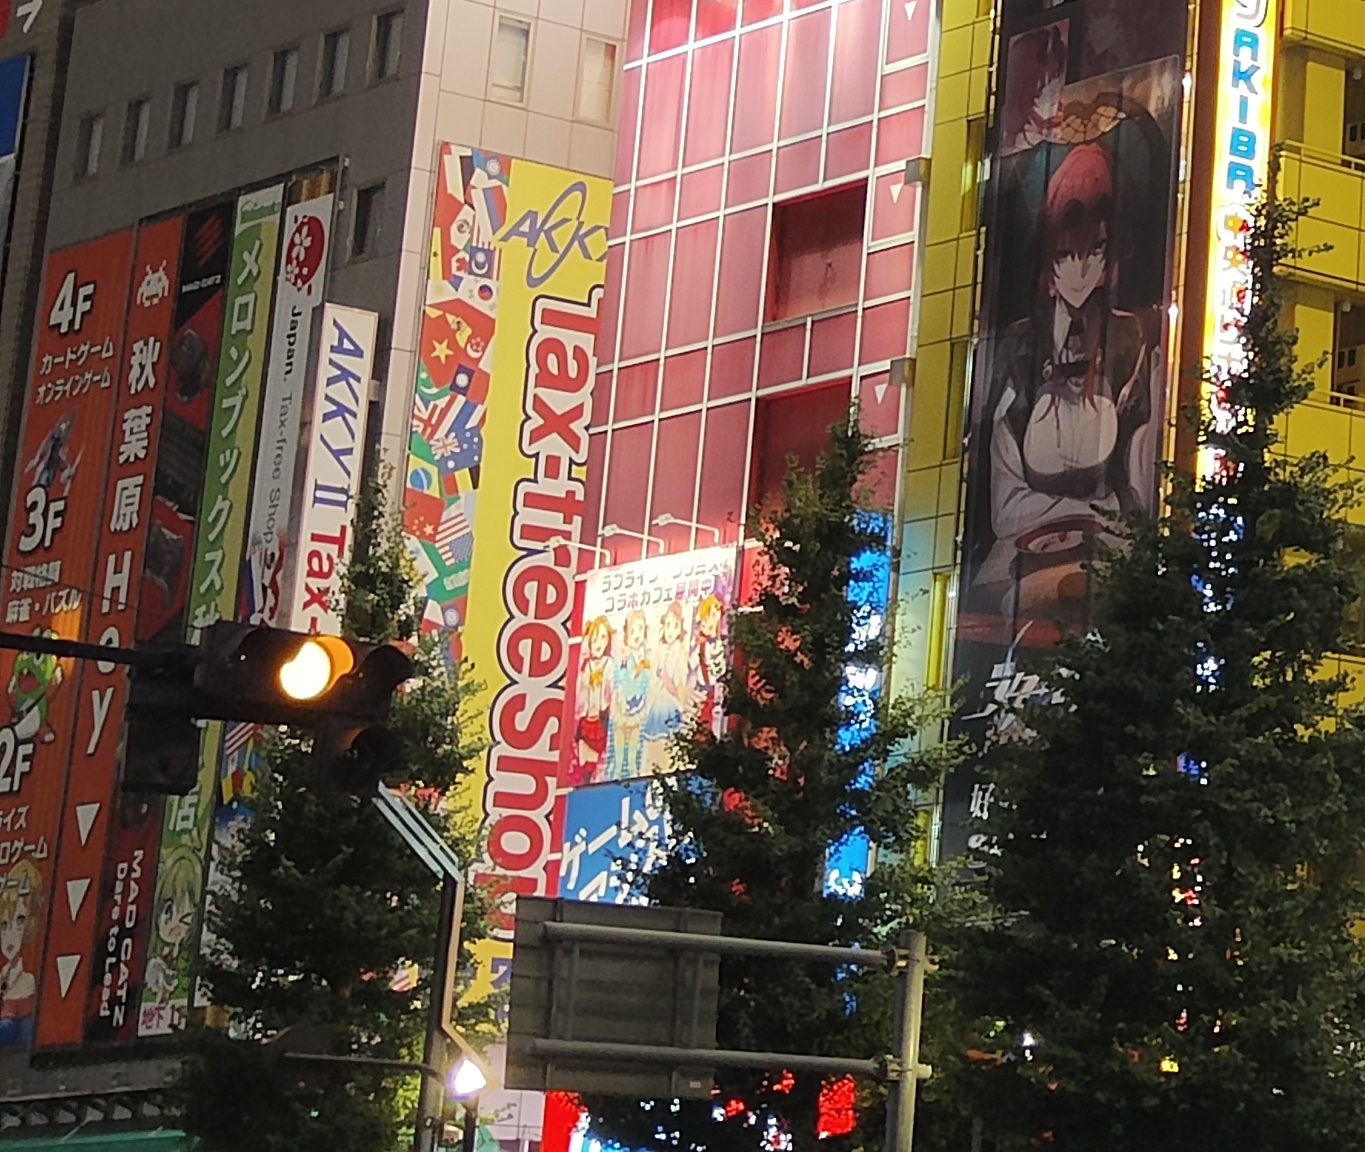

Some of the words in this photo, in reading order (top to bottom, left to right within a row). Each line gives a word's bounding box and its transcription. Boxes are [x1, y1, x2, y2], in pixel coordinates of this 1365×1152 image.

[1228, 30, 1260, 193] AKIBA
[500, 212, 610, 264] AKK
[48, 271, 96, 335] 4F
[35, 367, 111, 406] オンラインゲーム
[40, 336, 115, 376] カードゲーム
[109, 334, 161, 534] 秋葉原
[319, 317, 365, 478] AKKY
[270, 393, 294, 480] Tax-free
[18, 485, 67, 553] 3F
[0, 726, 35, 794] 2F
[122, 849, 144, 929] MAD
[111, 946, 135, 1028] CATZ
